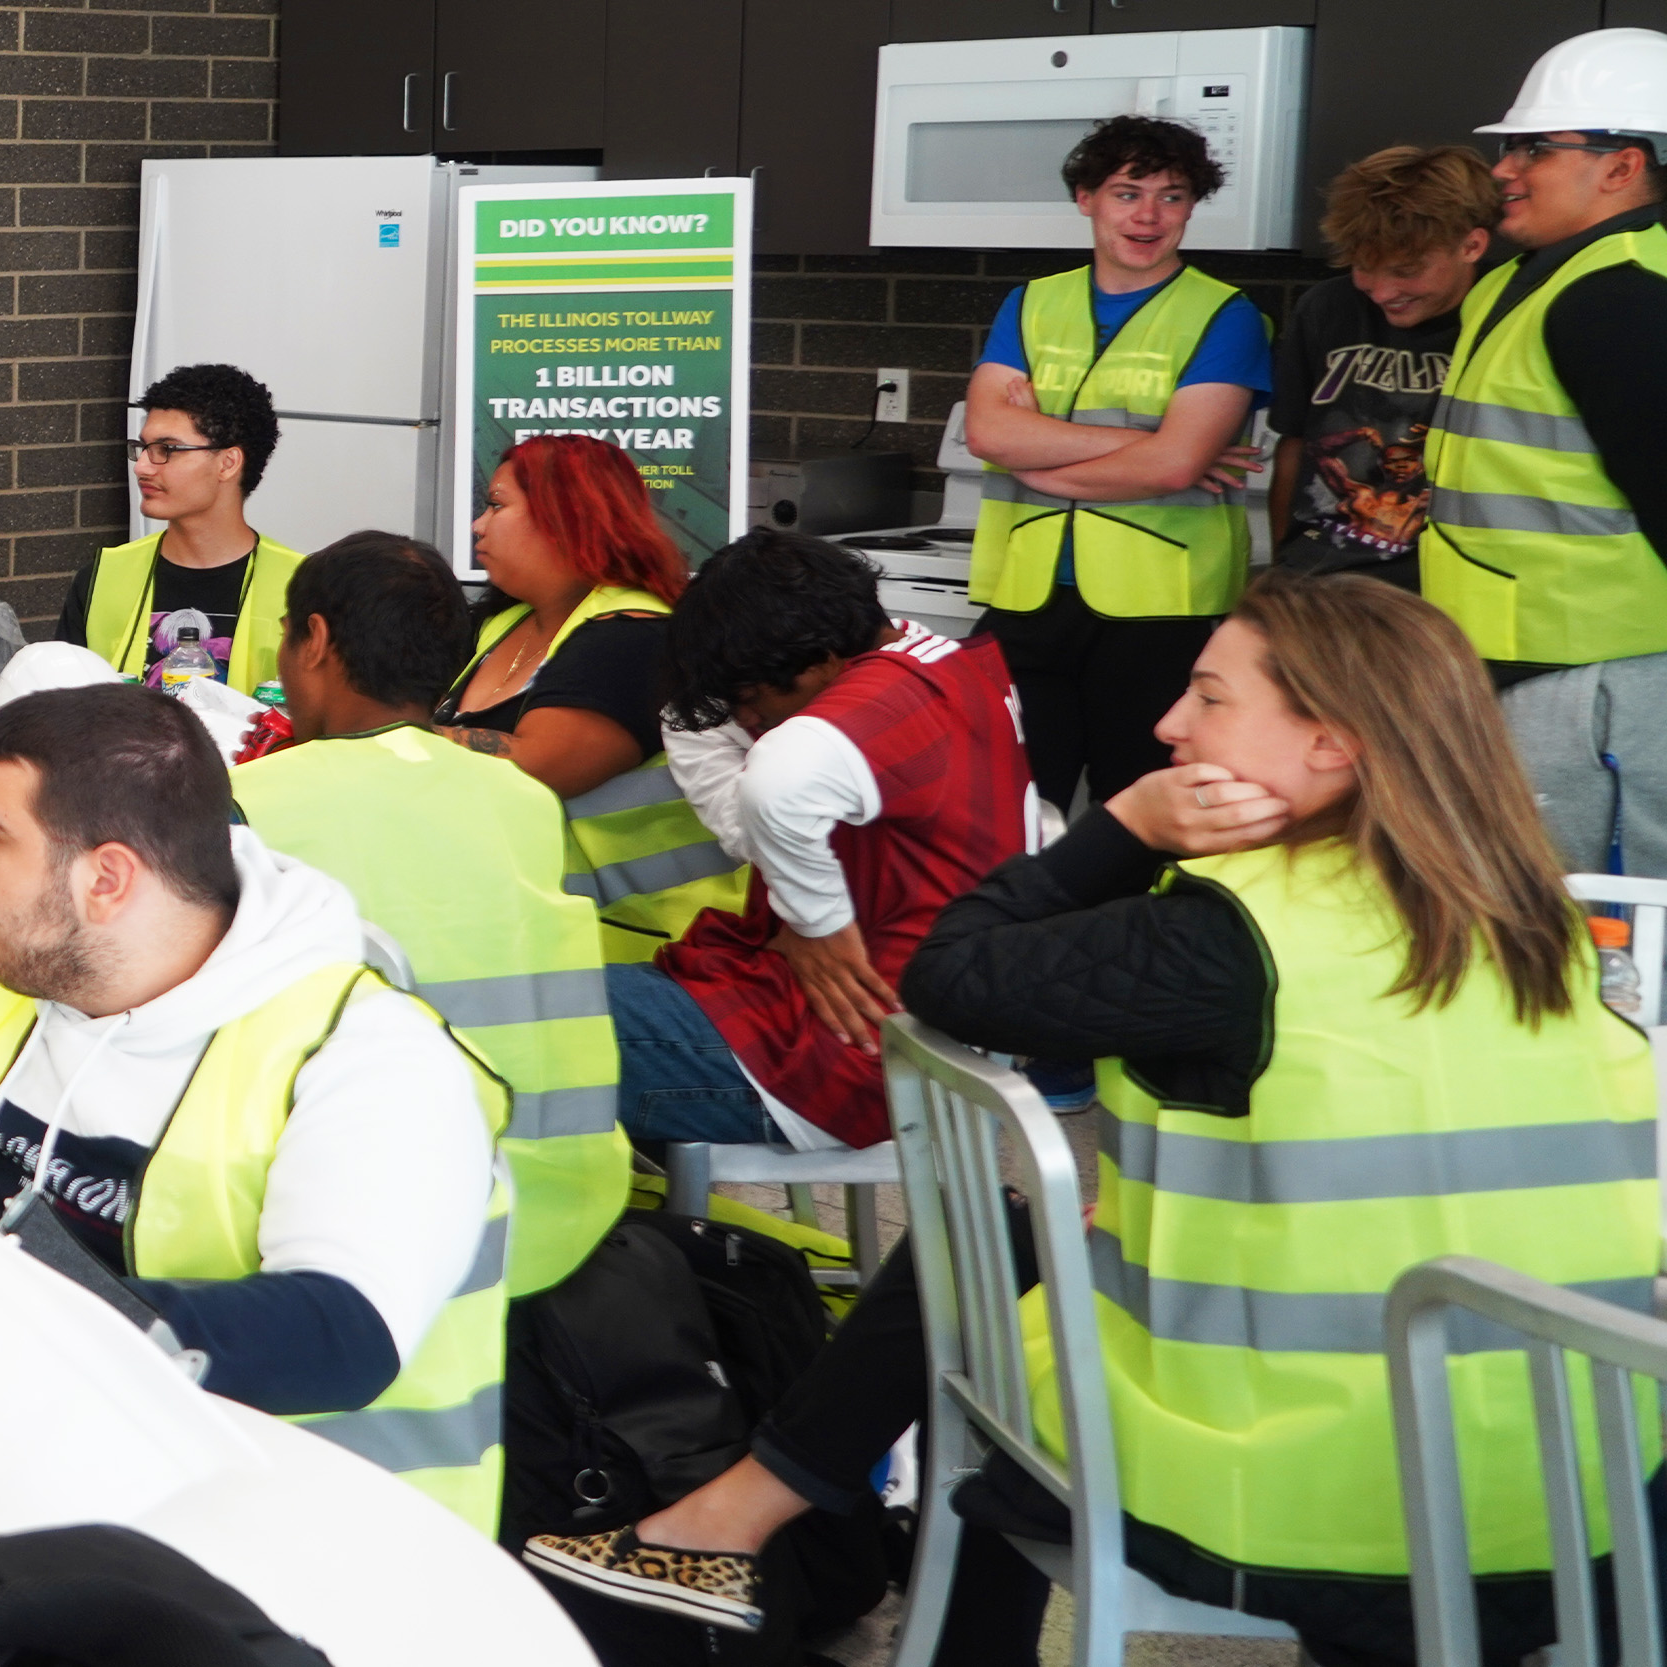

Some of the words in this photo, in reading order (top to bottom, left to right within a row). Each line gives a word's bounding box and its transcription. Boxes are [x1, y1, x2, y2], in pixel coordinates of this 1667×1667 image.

[375, 209, 403, 220] Whirlpool
[499, 218, 546, 238] DID
[550, 217, 606, 237] YOU
[609, 213, 709, 236] KNOW?
[497, 313, 537, 328] THE
[539, 312, 620, 328] ILLINOIS
[622, 310, 715, 326] TOLLWAY
[490, 338, 602, 354] PROCESSES
[604, 337, 661, 352] MORE
[664, 336, 722, 351] THAN
[535, 367, 553, 388] 1
[557, 364, 675, 387] BILLION
[488, 395, 723, 419] TRANSACTIONS
[612, 428, 696, 450] YEAR
[660, 464, 695, 476] TOLL
